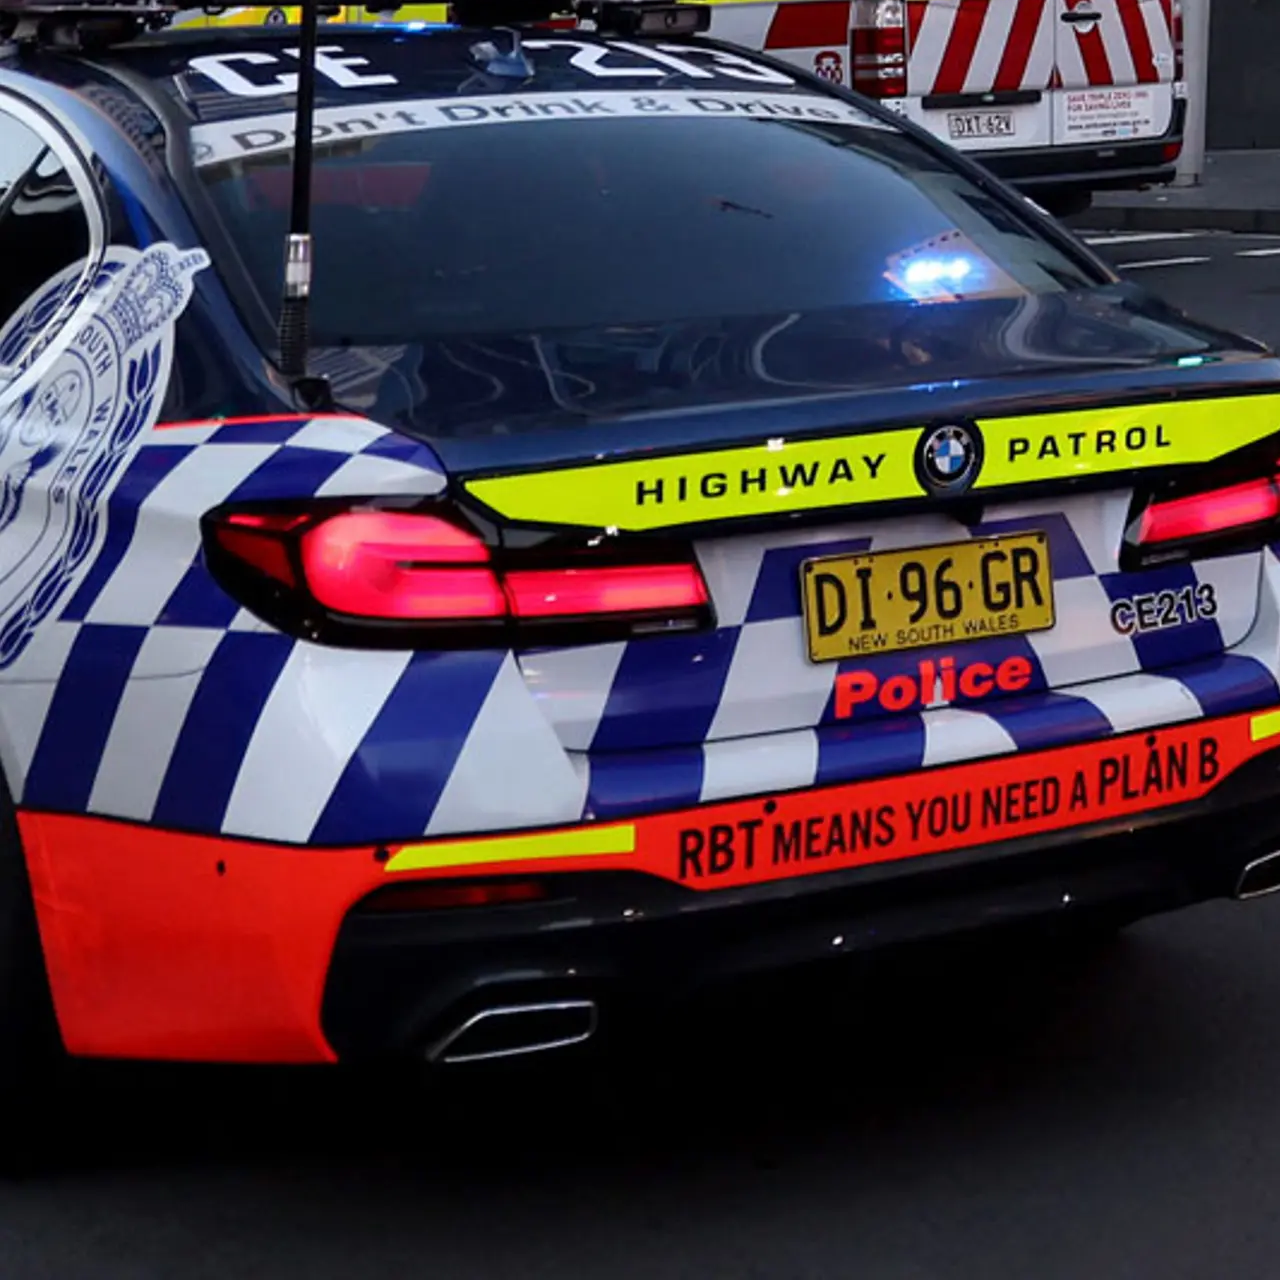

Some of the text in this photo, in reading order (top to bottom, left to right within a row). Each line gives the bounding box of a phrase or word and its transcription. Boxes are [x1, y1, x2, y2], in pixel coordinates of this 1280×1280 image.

[188, 40, 796, 98] CE 213
[230, 96, 839, 151] Don't Drink & Drive
[636, 423, 1172, 507] HIGHWAY PATROL
[848, 613, 1020, 652] NEW SOUTH WALES
[1110, 582, 1218, 635] CE213
[834, 655, 1033, 720] Police
[677, 737, 1220, 880] RBT MEANS YOU NEED A PLAN B
